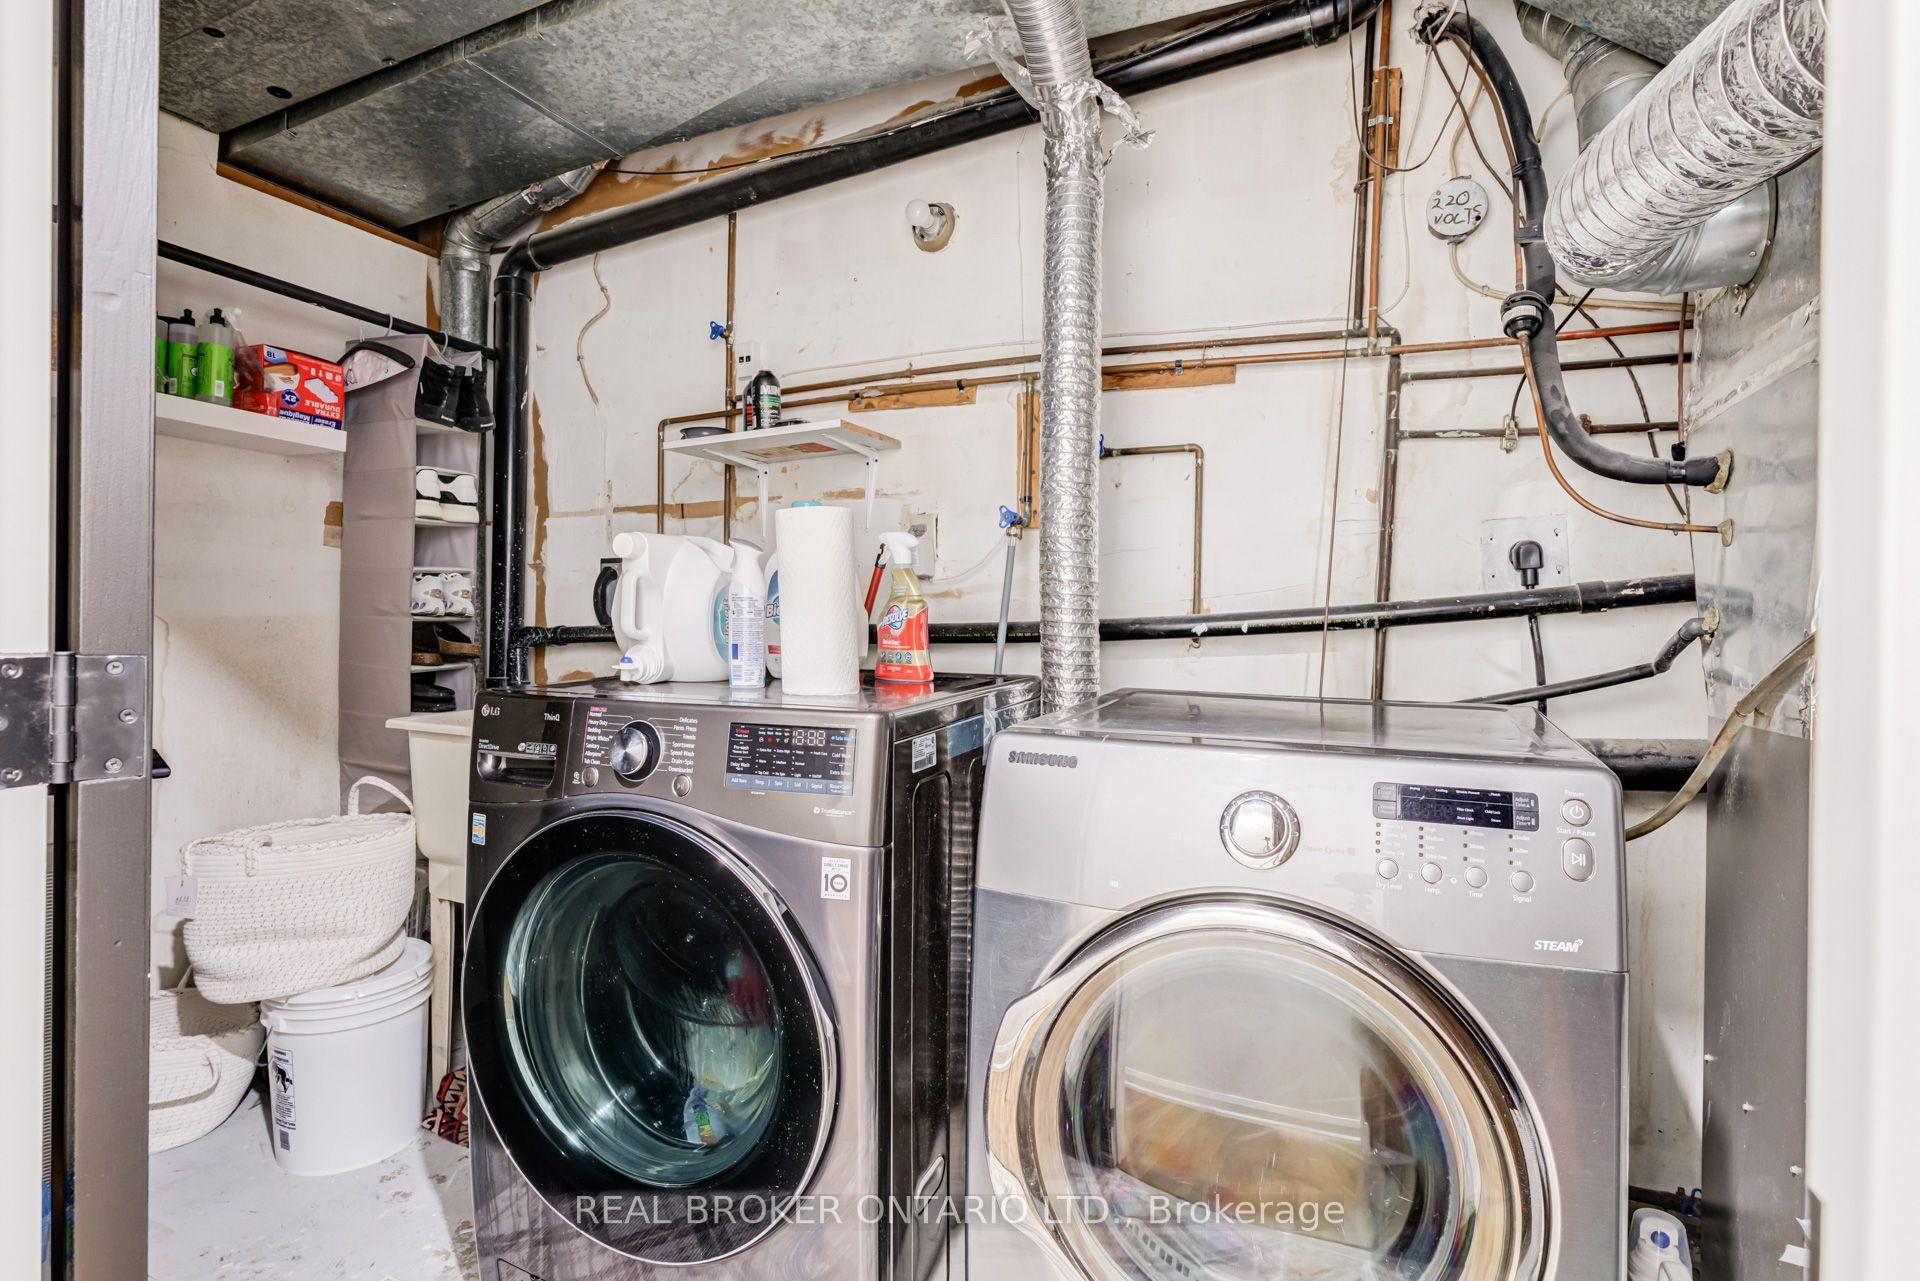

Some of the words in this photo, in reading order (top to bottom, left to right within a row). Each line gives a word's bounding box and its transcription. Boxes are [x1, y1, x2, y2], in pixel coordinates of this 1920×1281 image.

[1432, 190, 1470, 210] 220
[266, 350, 276, 359] 18
[284, 394, 297, 403] 2X
[305, 399, 341, 413] DURABLE
[280, 409, 311, 421] Magique
[315, 408, 341, 419] EXTRA
[314, 417, 336, 428] Eraser
[544, 712, 560, 722] ThinQ
[672, 741, 696, 749] Sportswear
[1008, 750, 1078, 769] SAMSUNG
[1564, 789, 1585, 797] Power
[1515, 815, 1530, 823] Adjust
[1556, 827, 1572, 835] Start
[1577, 829, 1596, 837] Pause
[824, 873, 848, 893] 10
[1376, 882, 1386, 890] Dry
[1424, 886, 1441, 895] Temp.
[1469, 891, 1483, 899] Time
[1512, 895, 1532, 904] Signal
[1534, 939, 1579, 953] STEAM
